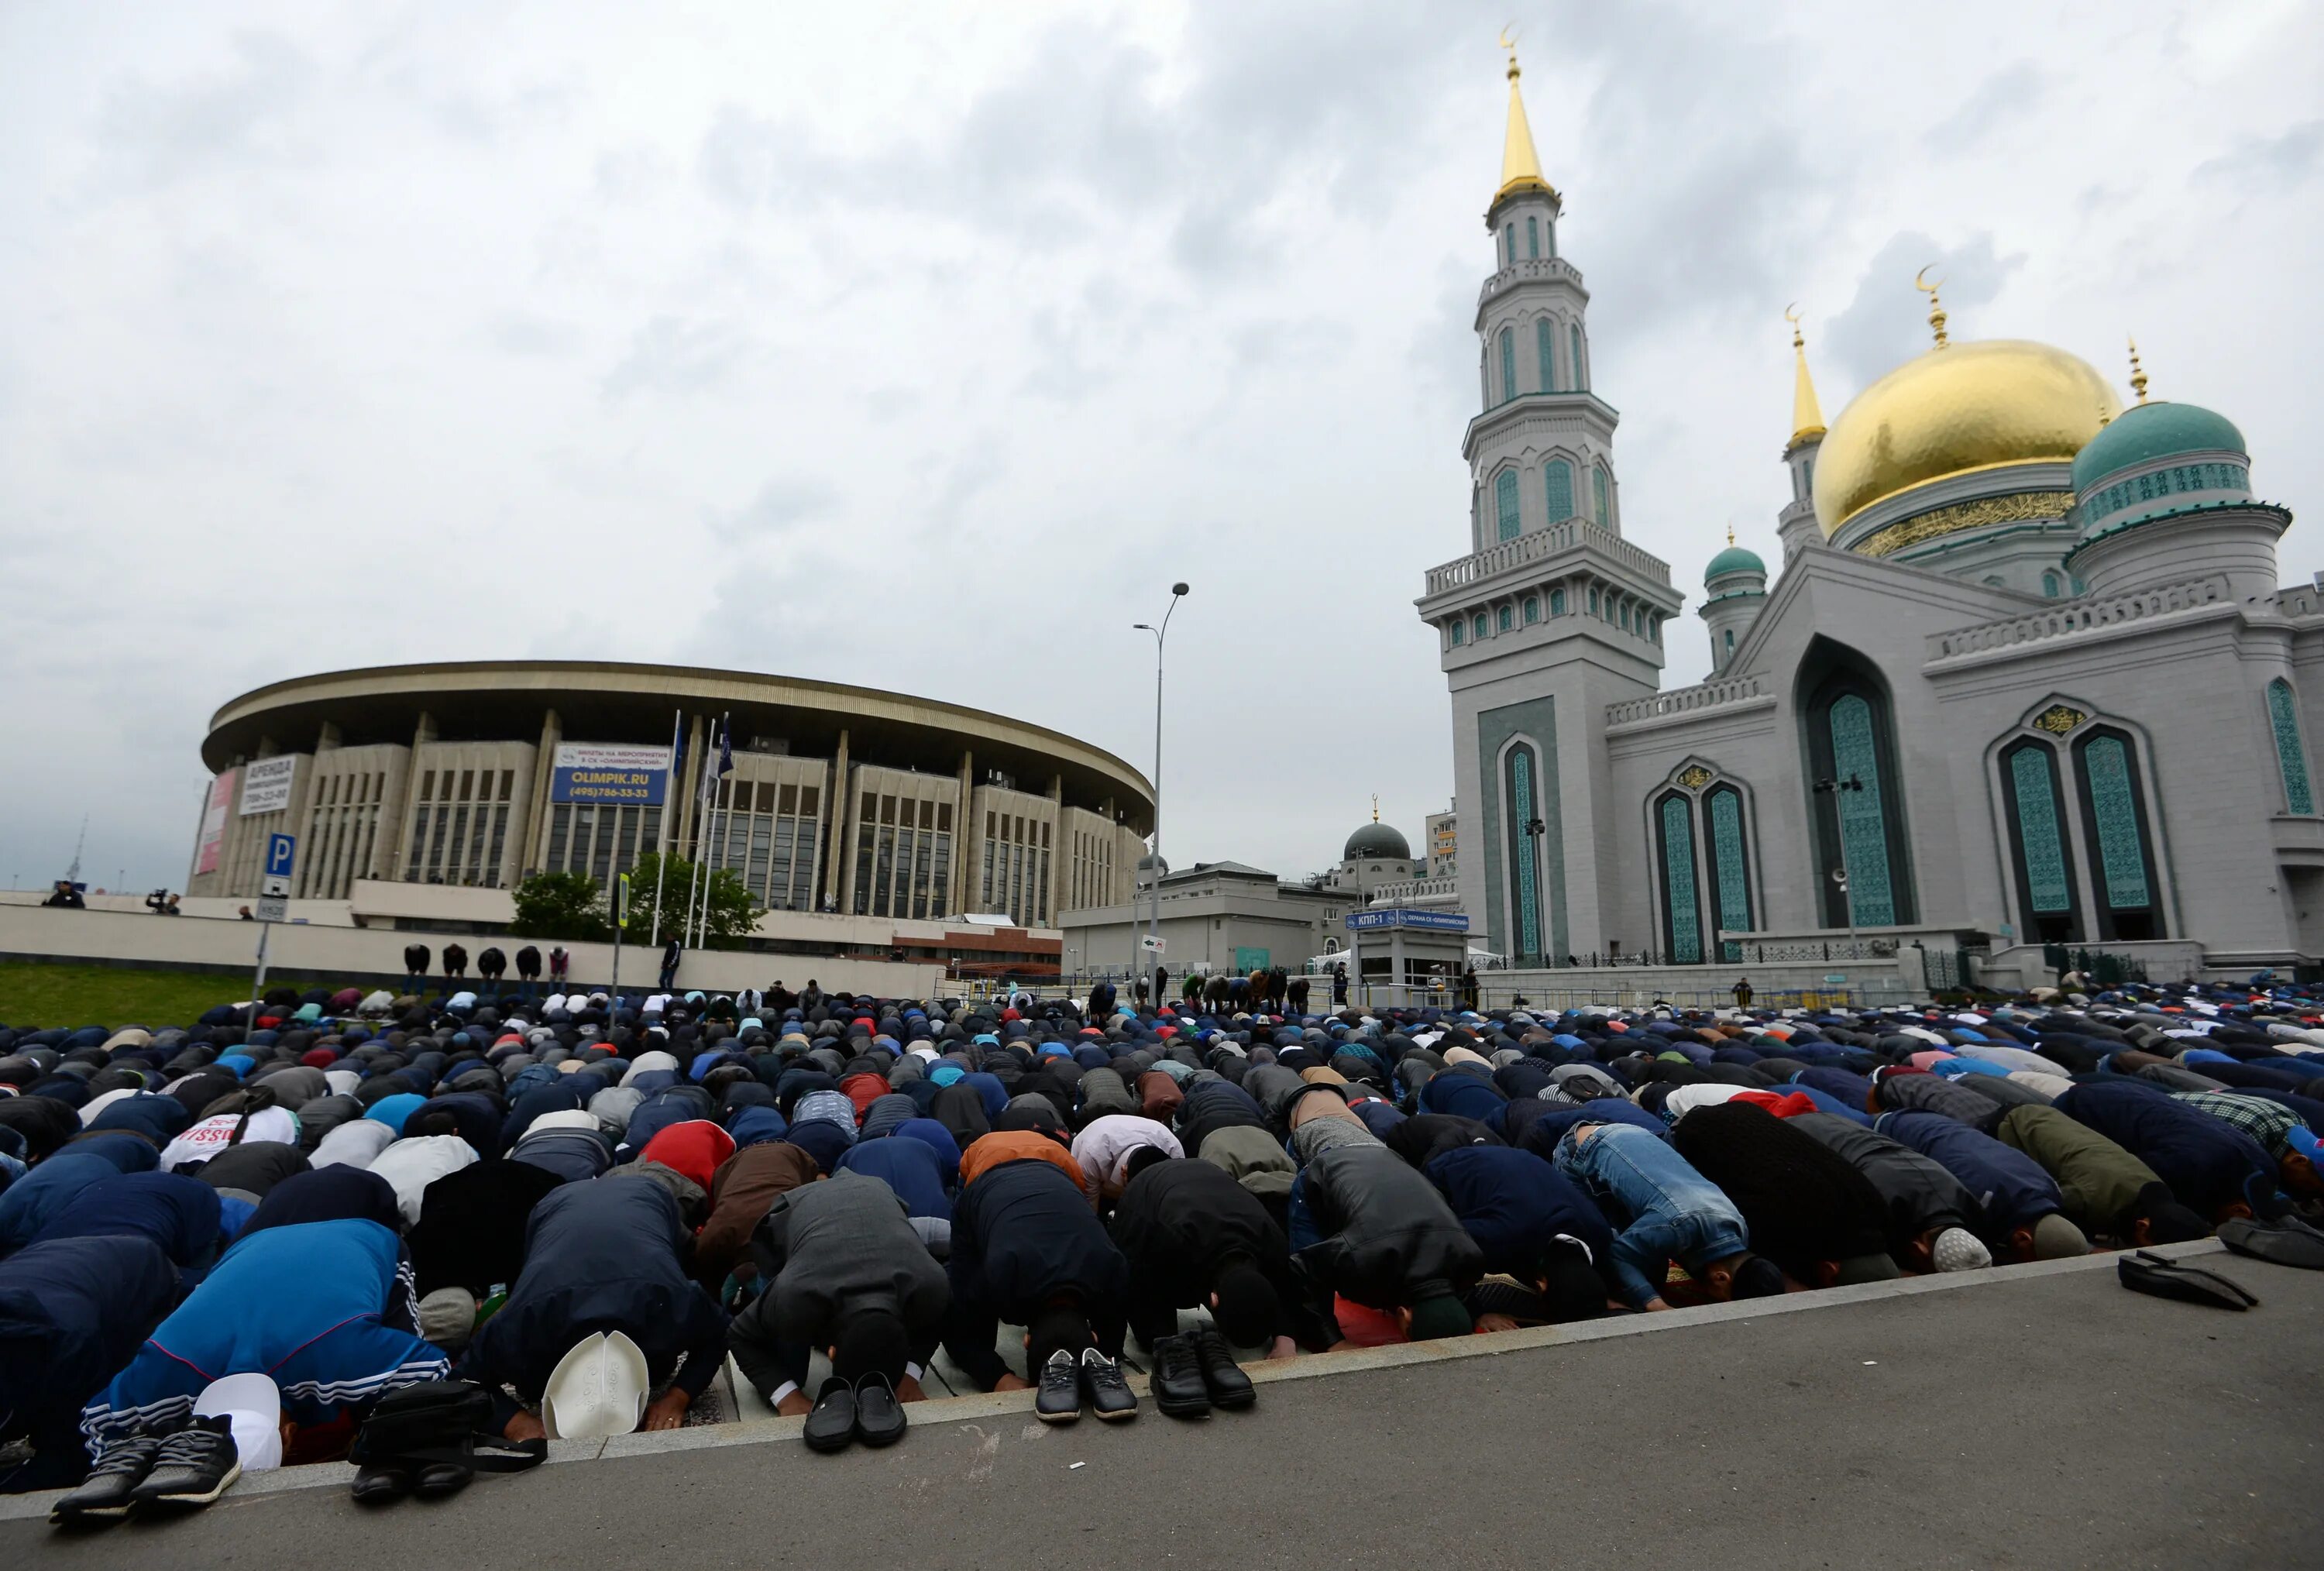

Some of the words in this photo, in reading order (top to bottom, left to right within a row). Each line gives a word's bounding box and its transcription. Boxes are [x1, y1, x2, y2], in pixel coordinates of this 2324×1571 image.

[250, 760, 291, 778] АРЕНДА
[571, 772, 648, 785] OLIMPIK.RU
[569, 788, 648, 798] (495)786-33-33
[273, 838, 290, 871] P
[1358, 914, 1383, 925] КПП-1
